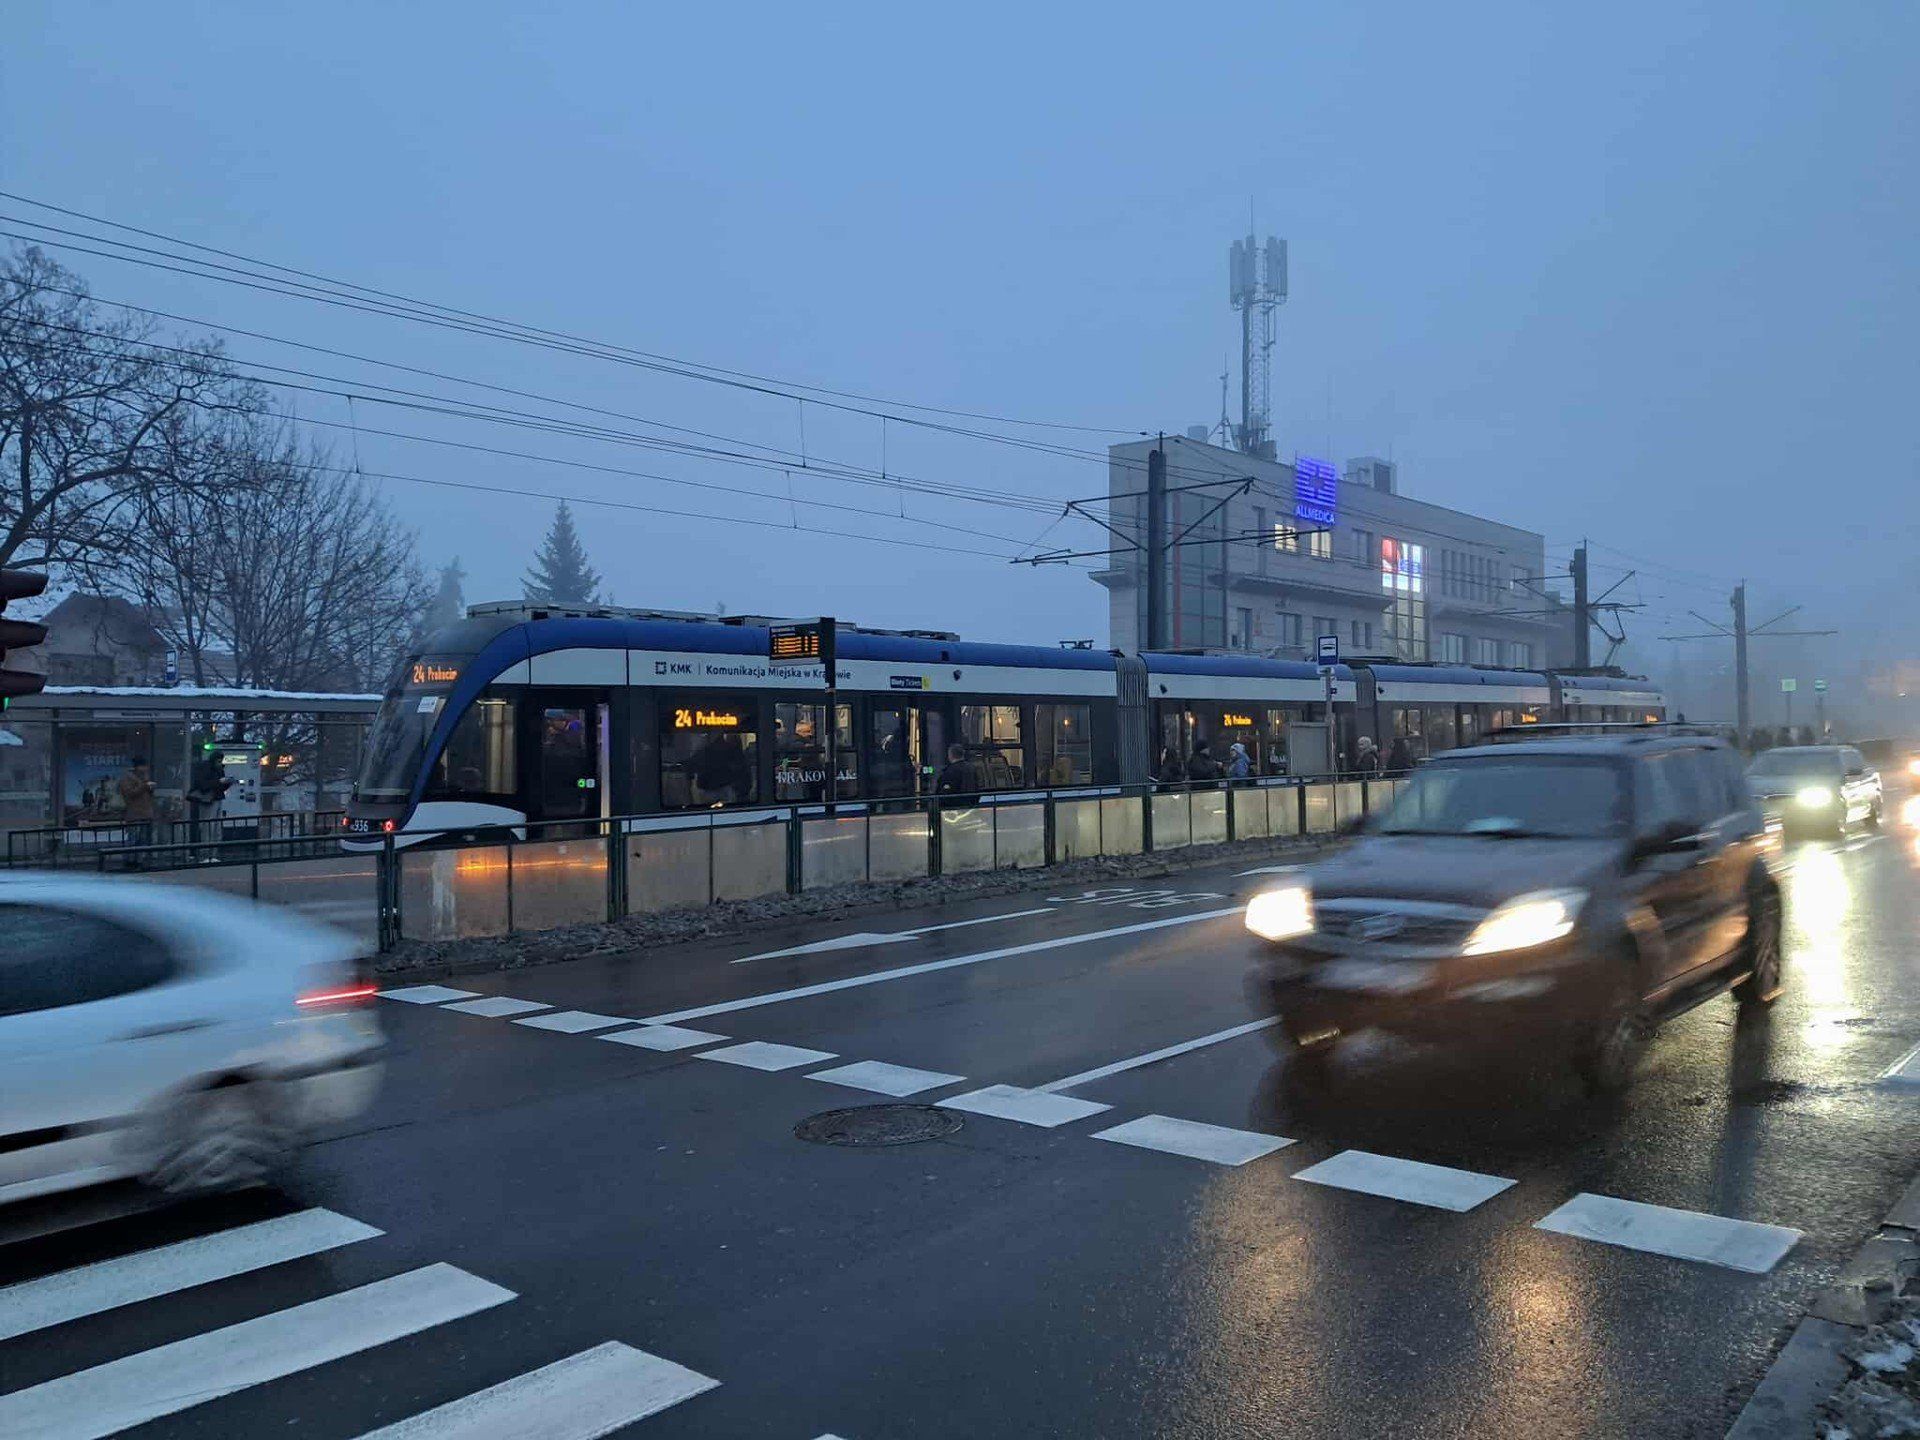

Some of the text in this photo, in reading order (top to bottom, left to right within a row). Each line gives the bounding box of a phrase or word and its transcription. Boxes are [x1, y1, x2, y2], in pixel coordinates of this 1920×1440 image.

[1296, 504, 1335, 525] ALLMEDICA
[413, 664, 425, 683] 24
[669, 663, 692, 675] KMK
[706, 664, 766, 679] Komunikacja
[768, 667, 803, 681] Miejska
[675, 709, 692, 728] 24
